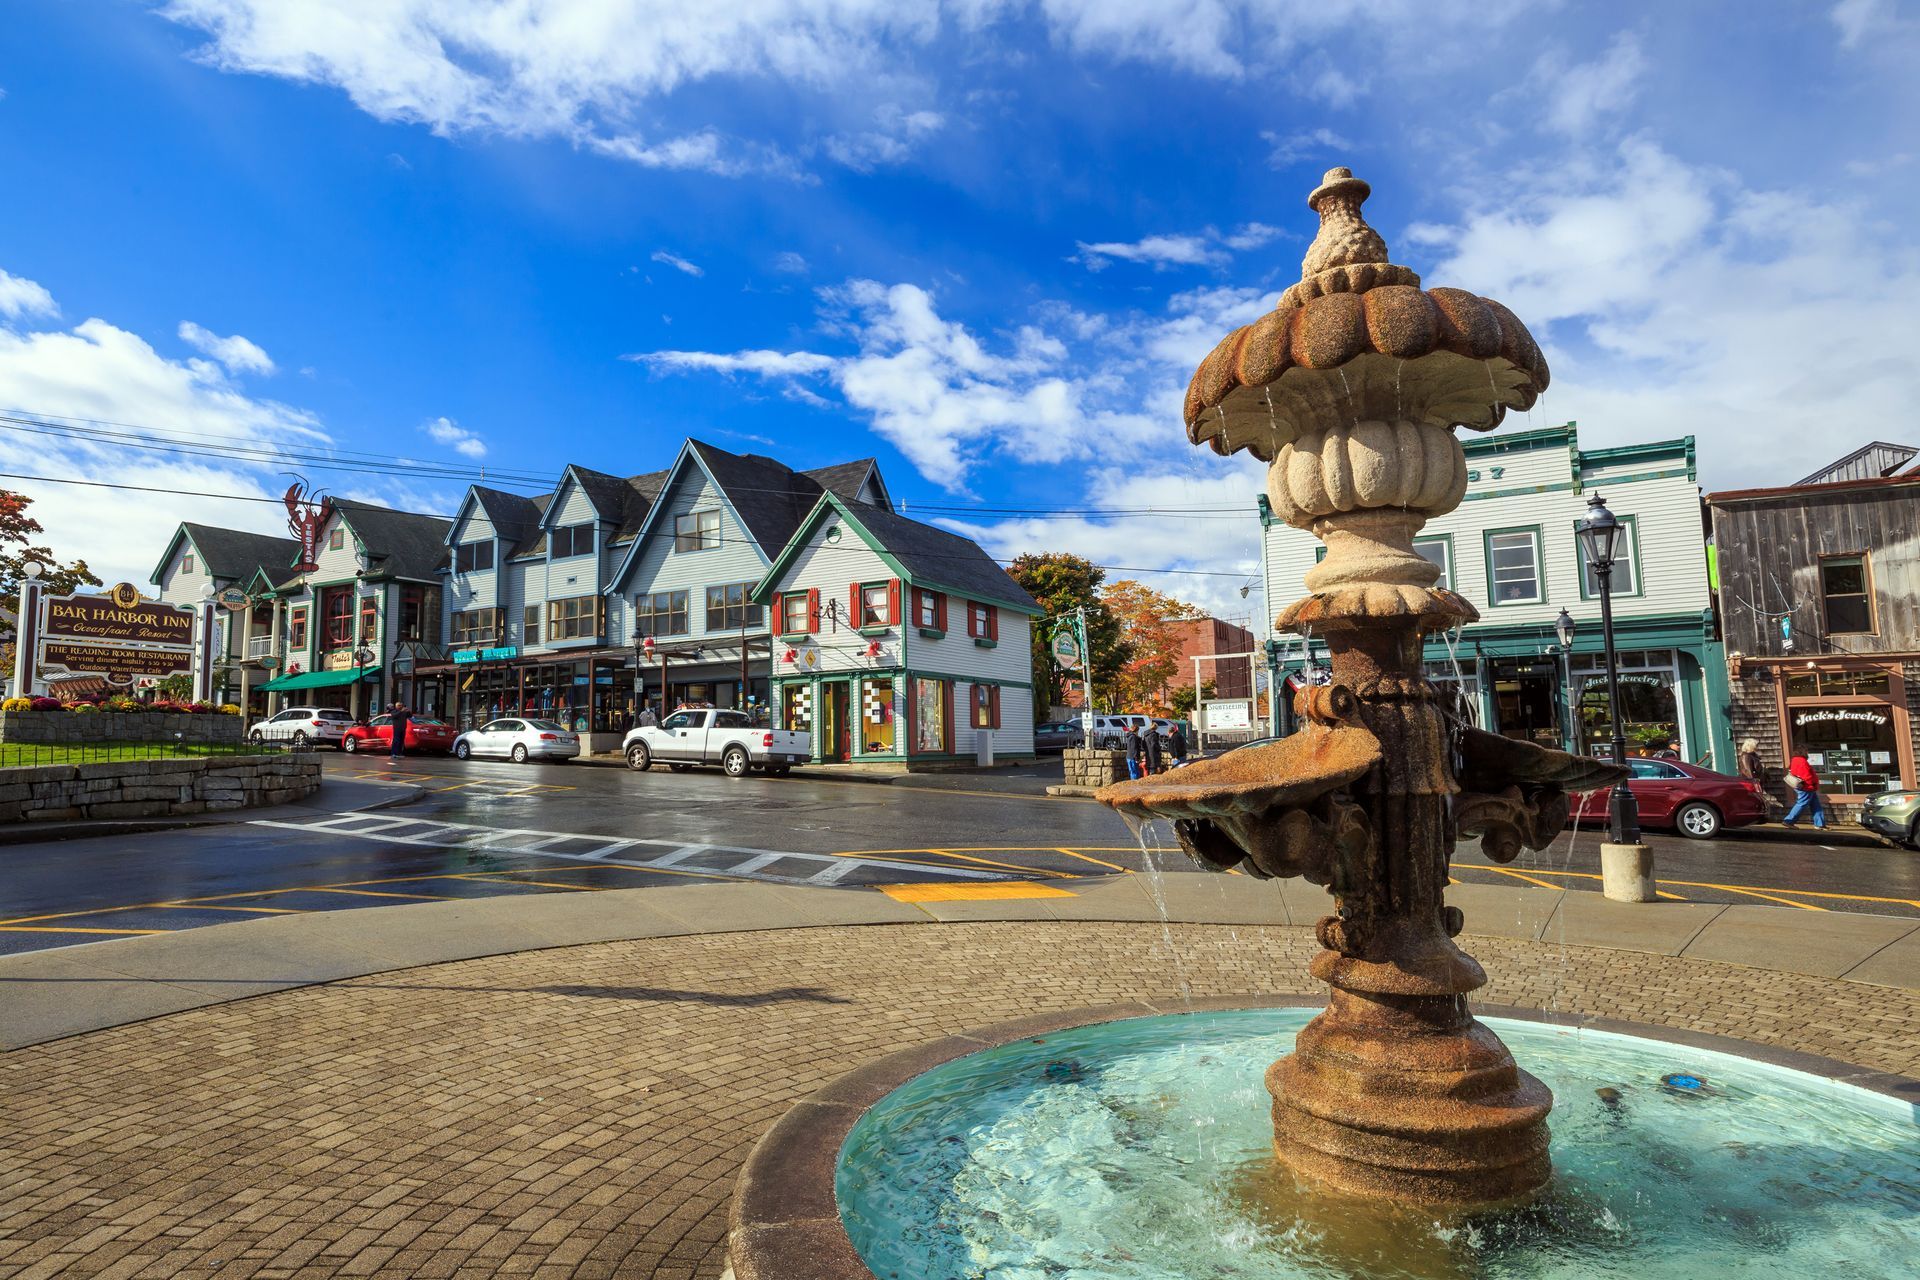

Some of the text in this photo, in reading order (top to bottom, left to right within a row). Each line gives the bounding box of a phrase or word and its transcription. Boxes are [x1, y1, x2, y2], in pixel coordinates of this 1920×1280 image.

[53, 605, 190, 628] BAR HARBOR INN
[73, 623, 172, 638] Oceanfront Resort
[49, 645, 189, 661] THE READING ROOM RESTAURANT
[65, 654, 94, 662] Serving
[97, 656, 118, 664] dinner
[122, 657, 145, 666] nightly
[110, 665, 145, 674] Waterfront
[1617, 674, 1660, 688] Jewelry
[1796, 709, 1887, 726] Jack's Jewelry
